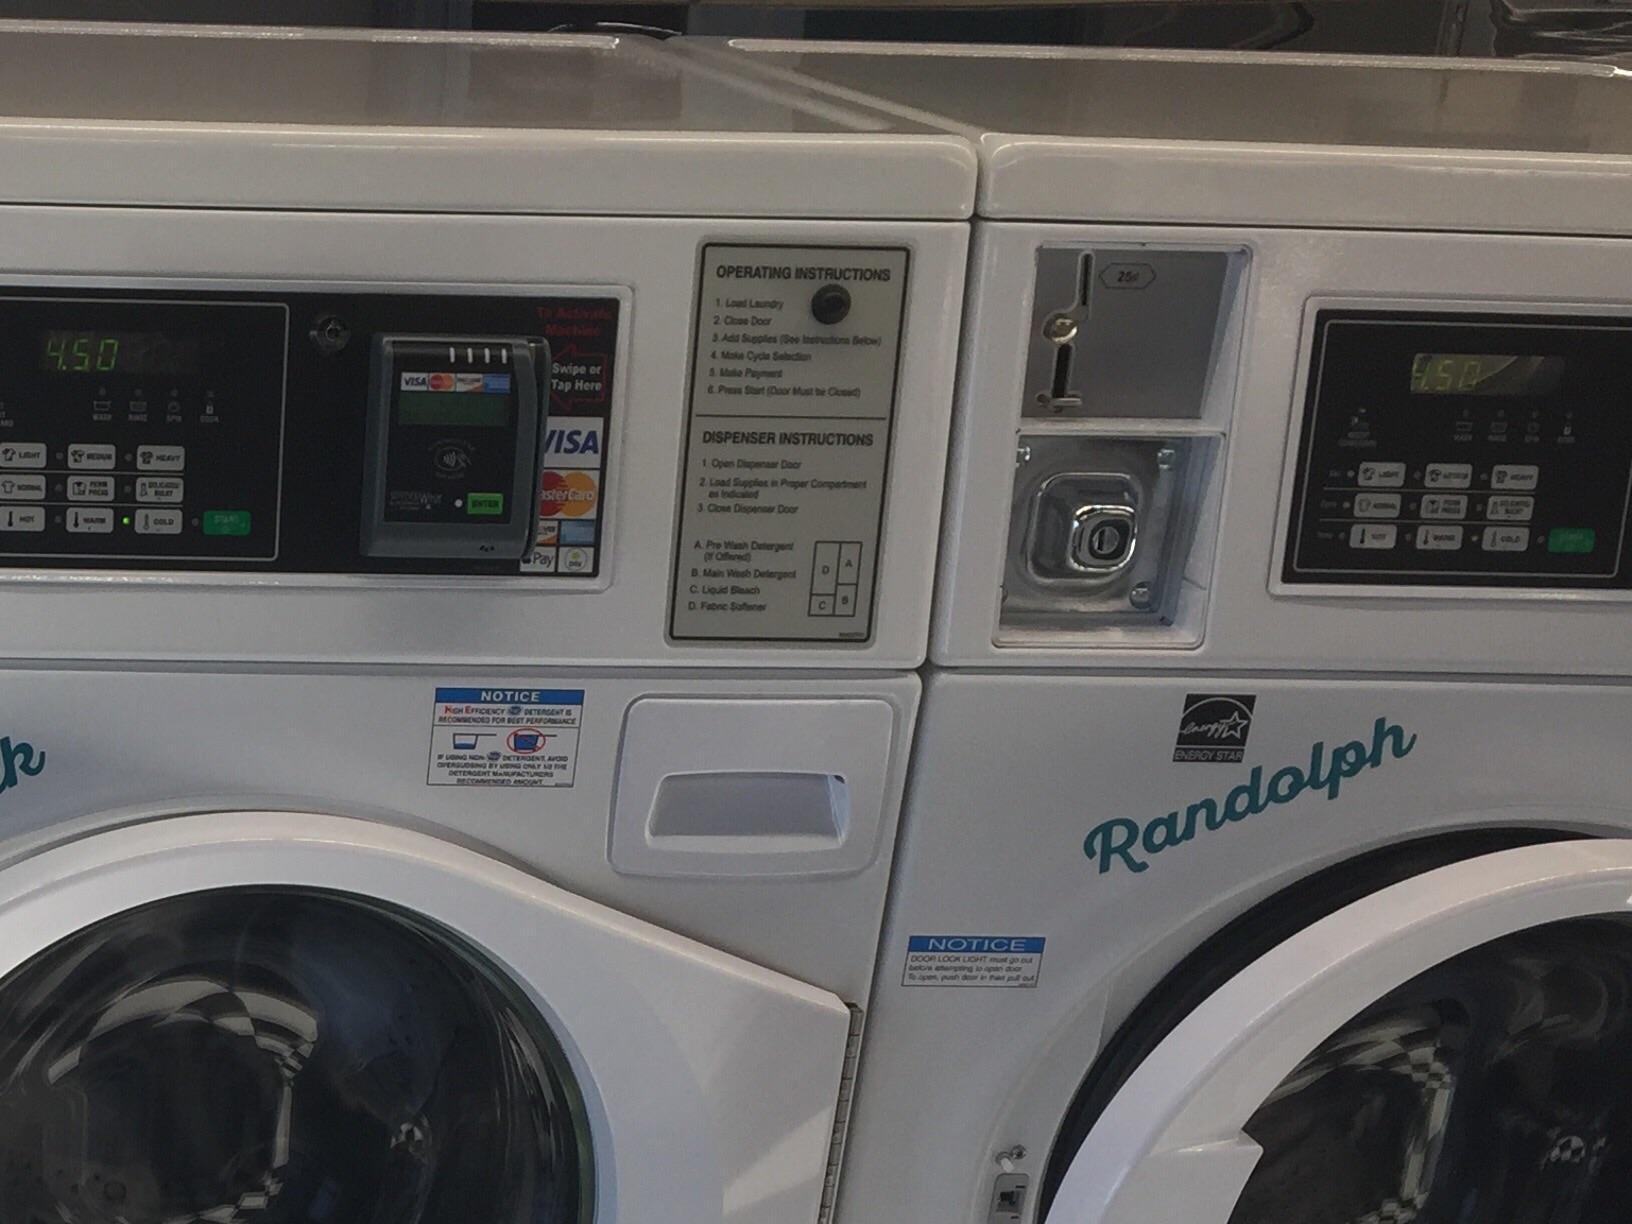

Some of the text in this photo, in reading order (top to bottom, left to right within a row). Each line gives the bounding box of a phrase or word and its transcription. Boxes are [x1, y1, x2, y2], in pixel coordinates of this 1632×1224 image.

[717, 265, 890, 281] OPERATING INSTRUCTIONS
[725, 299, 784, 311] Load Laundry
[724, 317, 772, 326] Close Door
[46, 339, 117, 371] 4.50
[552, 362, 602, 376] Swipe or
[404, 377, 427, 386] VISA
[551, 379, 602, 393] Tap Here
[703, 431, 873, 446] DISPENSER INSTRUCTIONS
[712, 460, 802, 471] Open Dispenser Door
[540, 489, 593, 500] asterCard
[533, 552, 553, 568] Pay
[481, 691, 541, 702] NOTICE
[1175, 749, 1243, 762] ENERGY STAR
[1084, 716, 1417, 875] Randolph
[928, 938, 1026, 951] NOTICE
